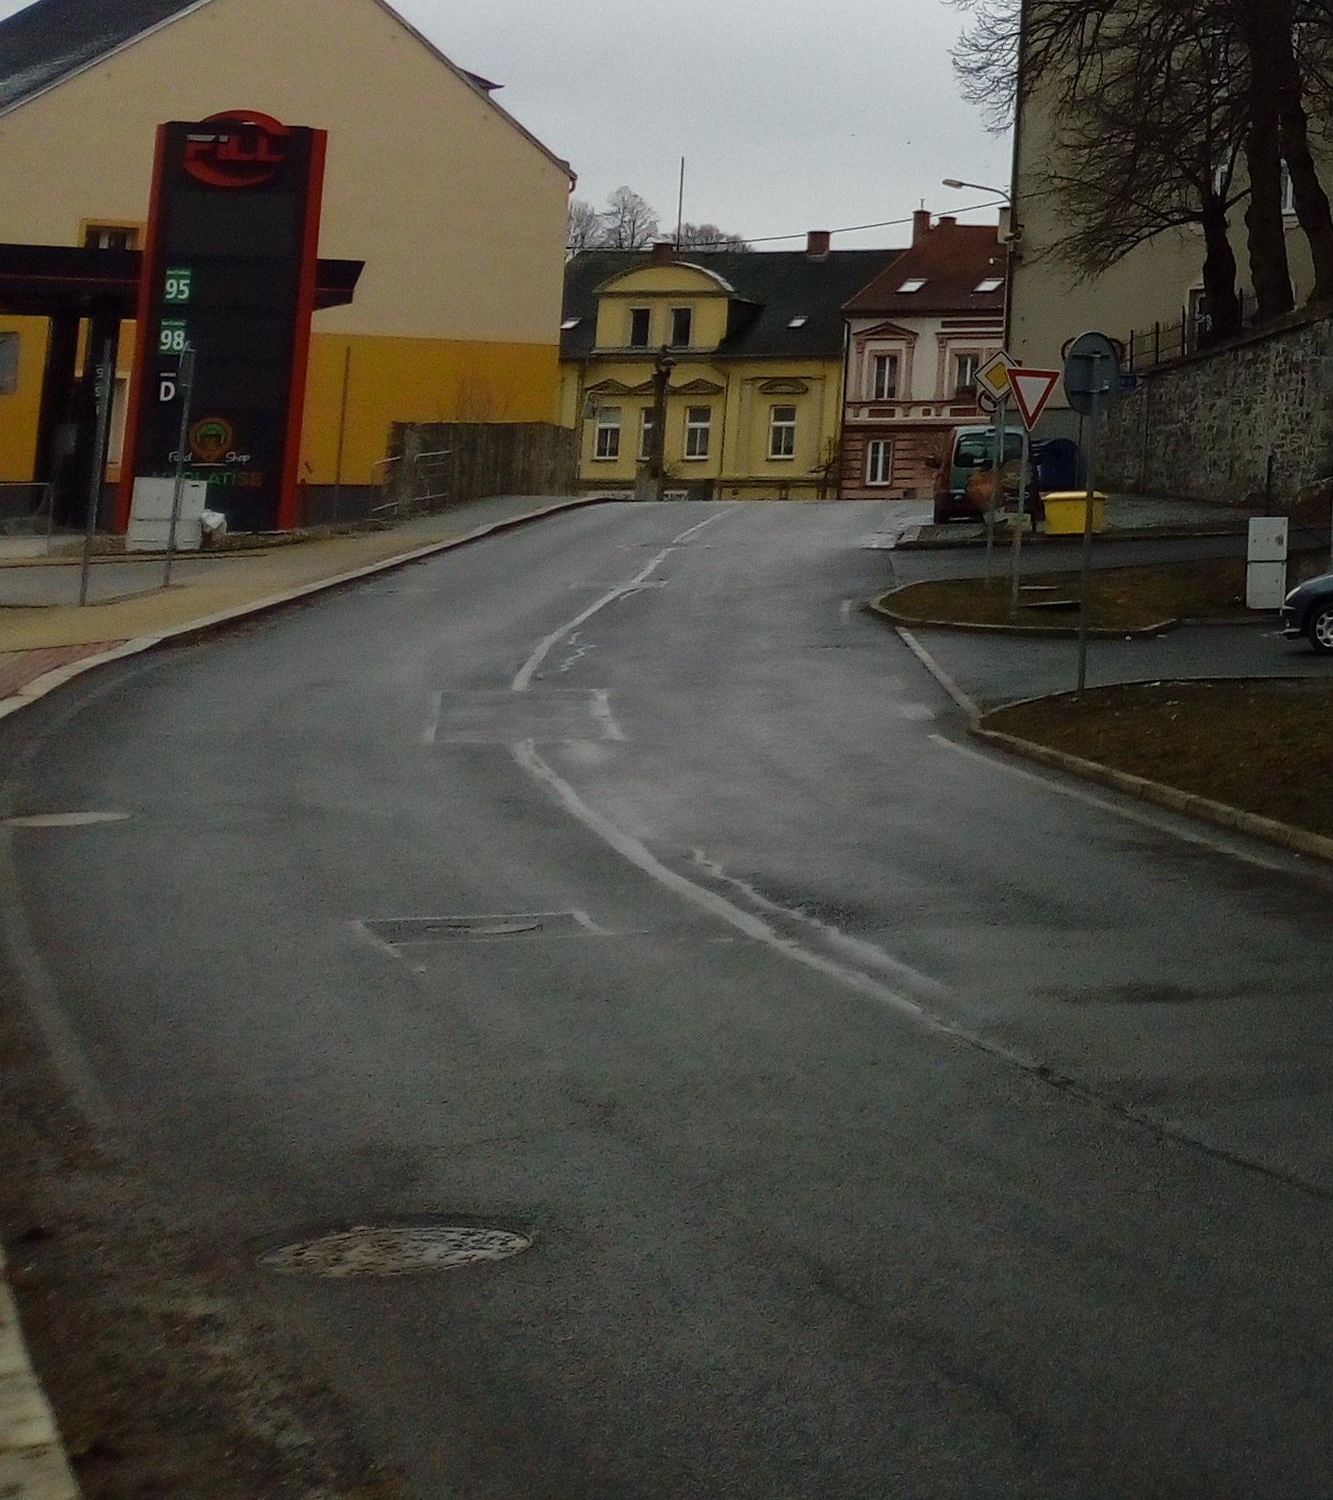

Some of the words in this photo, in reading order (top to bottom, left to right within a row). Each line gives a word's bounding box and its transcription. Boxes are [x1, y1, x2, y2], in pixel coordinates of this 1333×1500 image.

[165, 279, 190, 299] 95
[159, 330, 185, 350] 98
[159, 381, 176, 402] D
[168, 451, 192, 463] Fod
